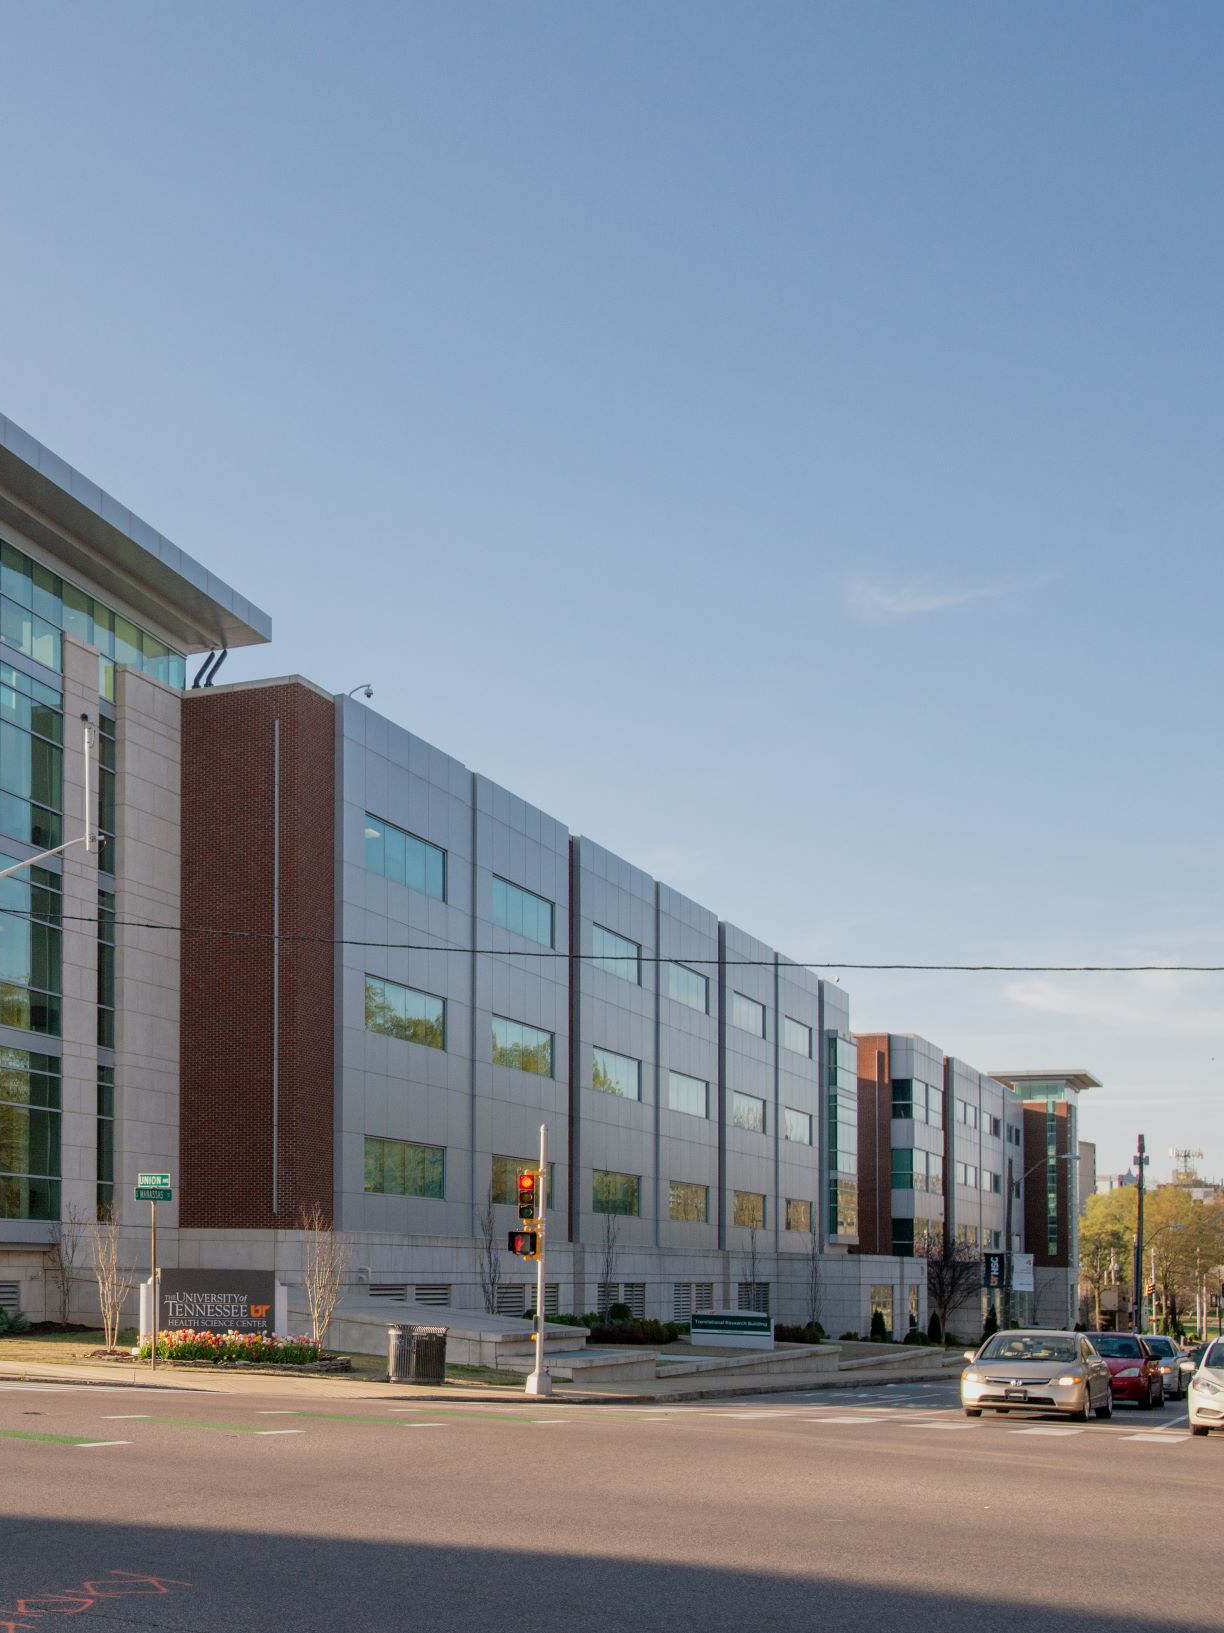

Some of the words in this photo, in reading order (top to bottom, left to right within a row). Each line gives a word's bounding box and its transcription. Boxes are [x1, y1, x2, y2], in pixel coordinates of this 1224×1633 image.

[139, 1175, 161, 1185] UNION
[140, 1190, 164, 1199] MANASSAS
[176, 1292, 240, 1303] UNIVERSITY
[239, 1293, 248, 1303] of
[164, 1300, 248, 1317] TENNESSEE
[250, 1304, 271, 1318] UT
[168, 1319, 200, 1327] HEALTH
[201, 1319, 235, 1327] SCIENCE
[236, 1320, 267, 1328] CENTER
